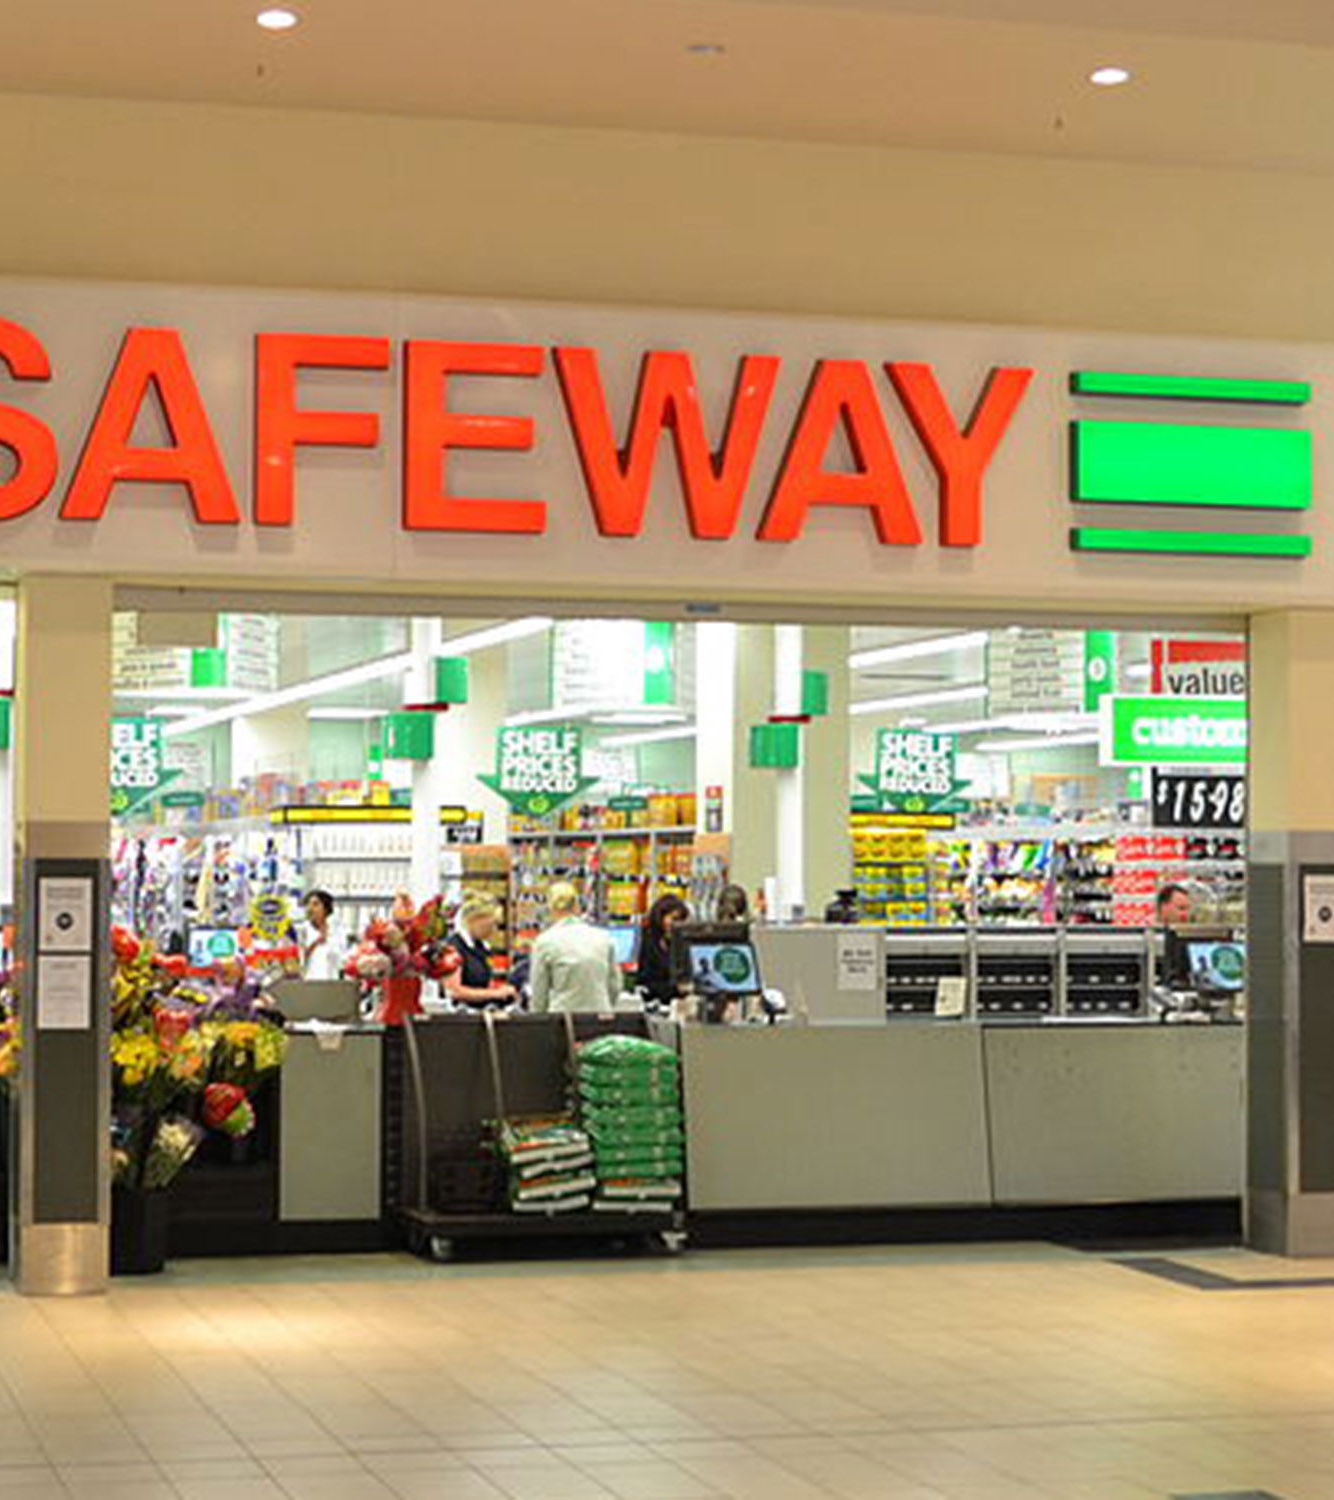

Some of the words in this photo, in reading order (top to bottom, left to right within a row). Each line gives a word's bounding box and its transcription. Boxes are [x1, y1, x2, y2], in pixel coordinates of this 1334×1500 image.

[1168, 668, 1245, 695] value
[112, 722, 160, 748] ELF
[502, 729, 578, 757] SHELF
[880, 732, 953, 758] SHELF
[501, 754, 578, 780] PRICES
[879, 756, 952, 780] PRICES
[500, 776, 578, 794] REDUCED
